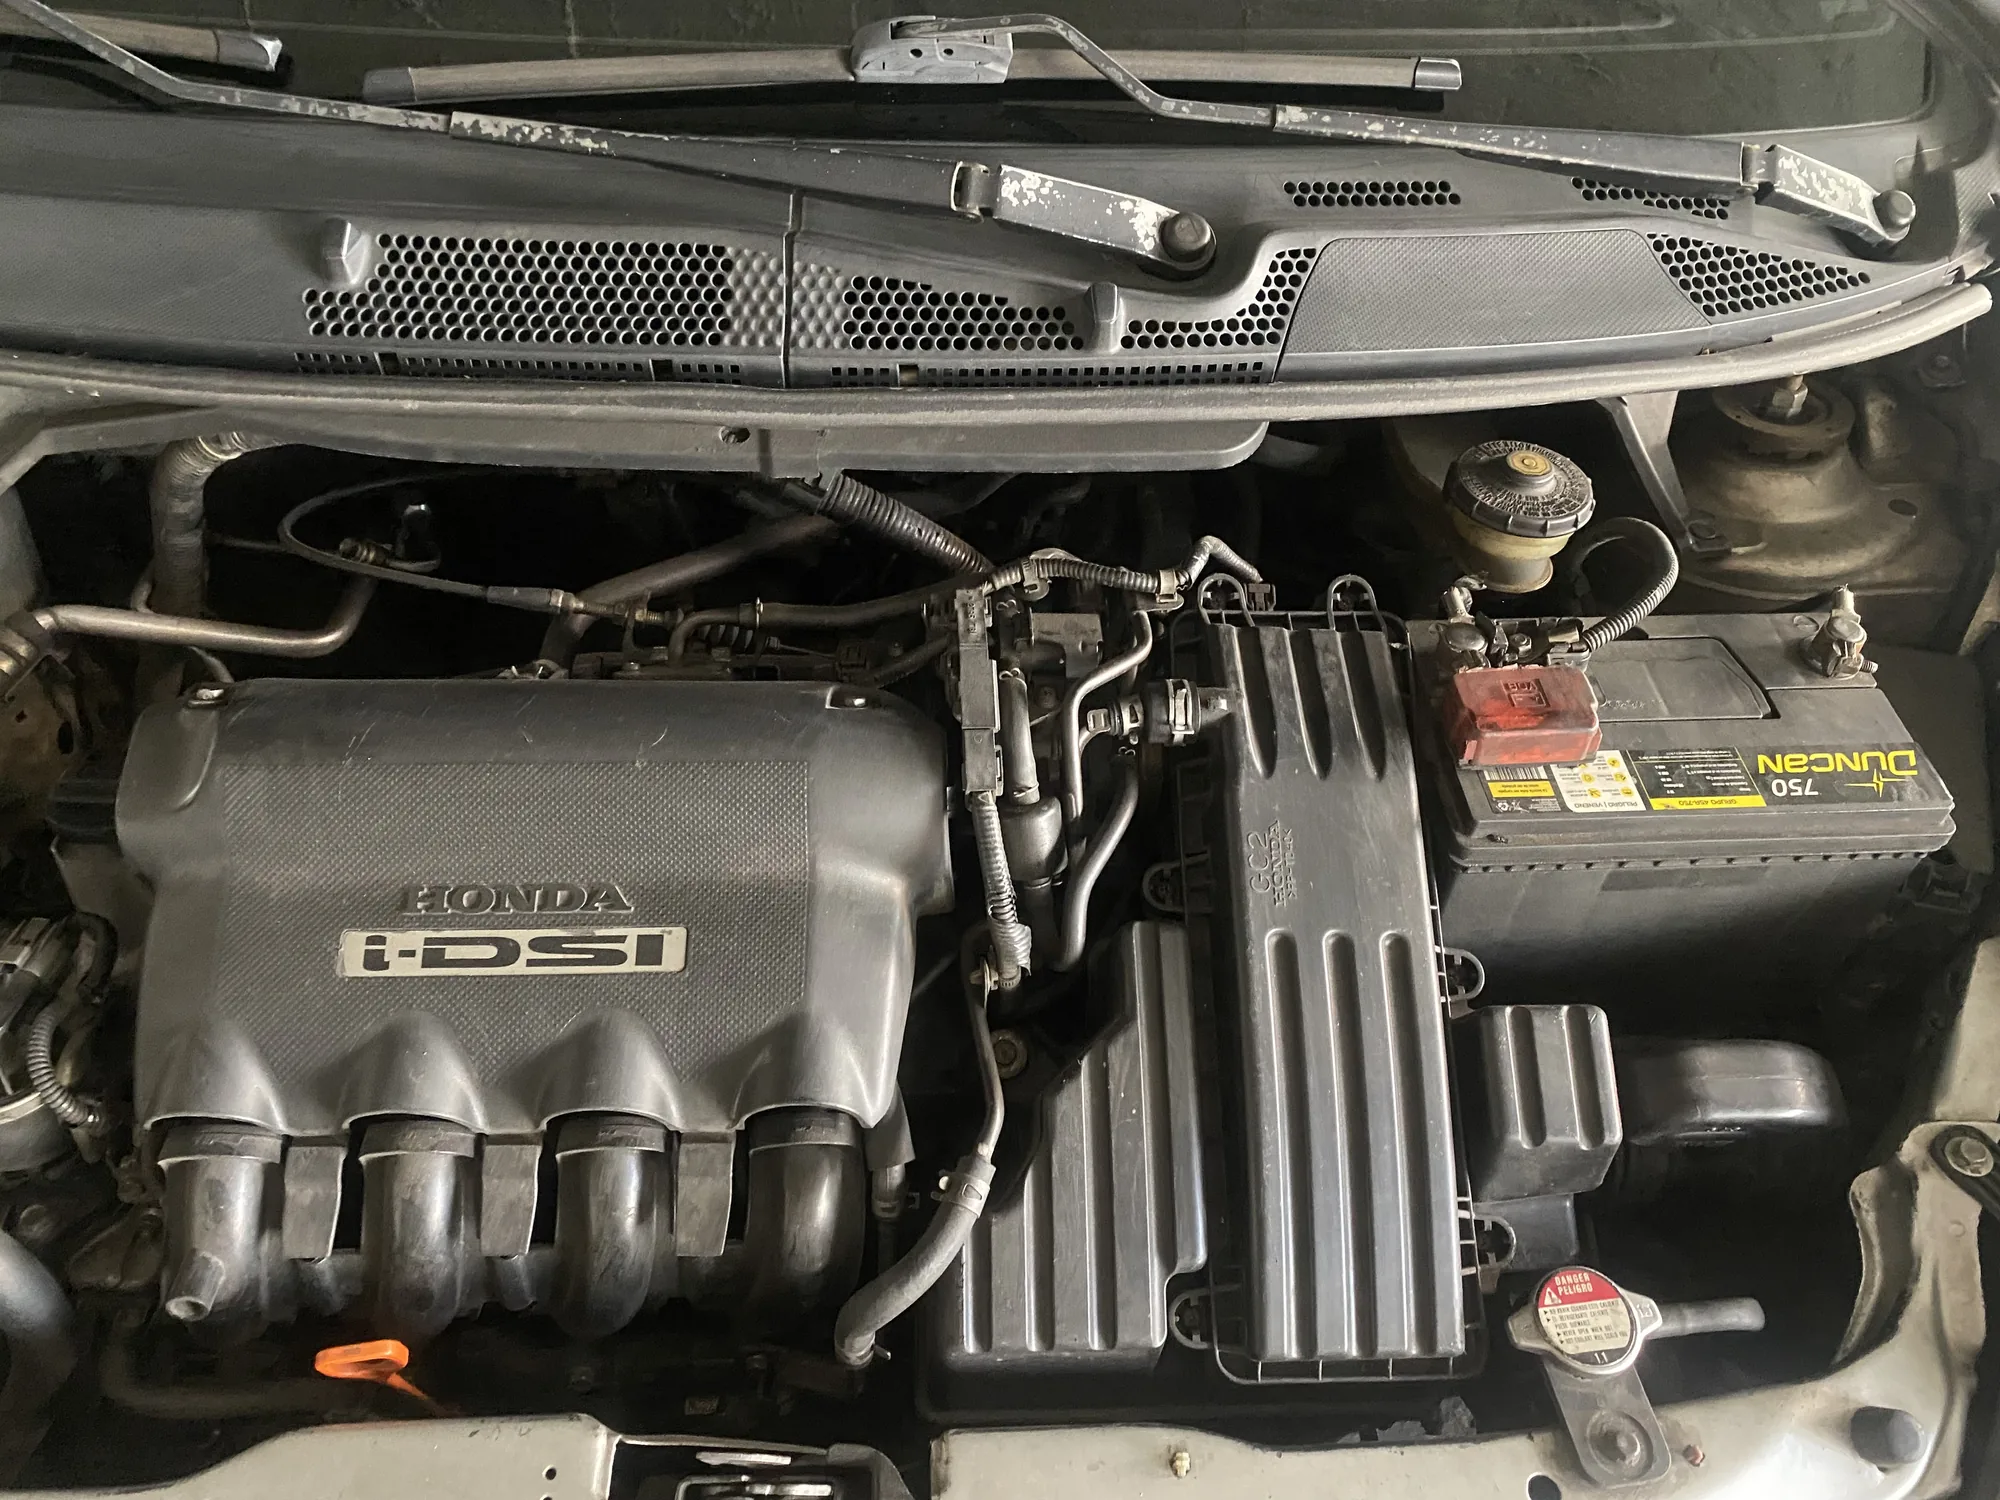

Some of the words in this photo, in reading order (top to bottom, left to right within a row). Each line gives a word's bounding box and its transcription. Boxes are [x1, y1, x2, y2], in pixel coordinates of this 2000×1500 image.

[1772, 778, 1818, 796] 750
[1247, 831, 1270, 893] GC2
[1268, 820, 1286, 908] HONDA
[398, 883, 634, 915] HONDA
[362, 934, 664, 971] i-DSI
[1555, 1273, 1590, 1286] DANGER
[1558, 1283, 1593, 1296] PELIGRO
